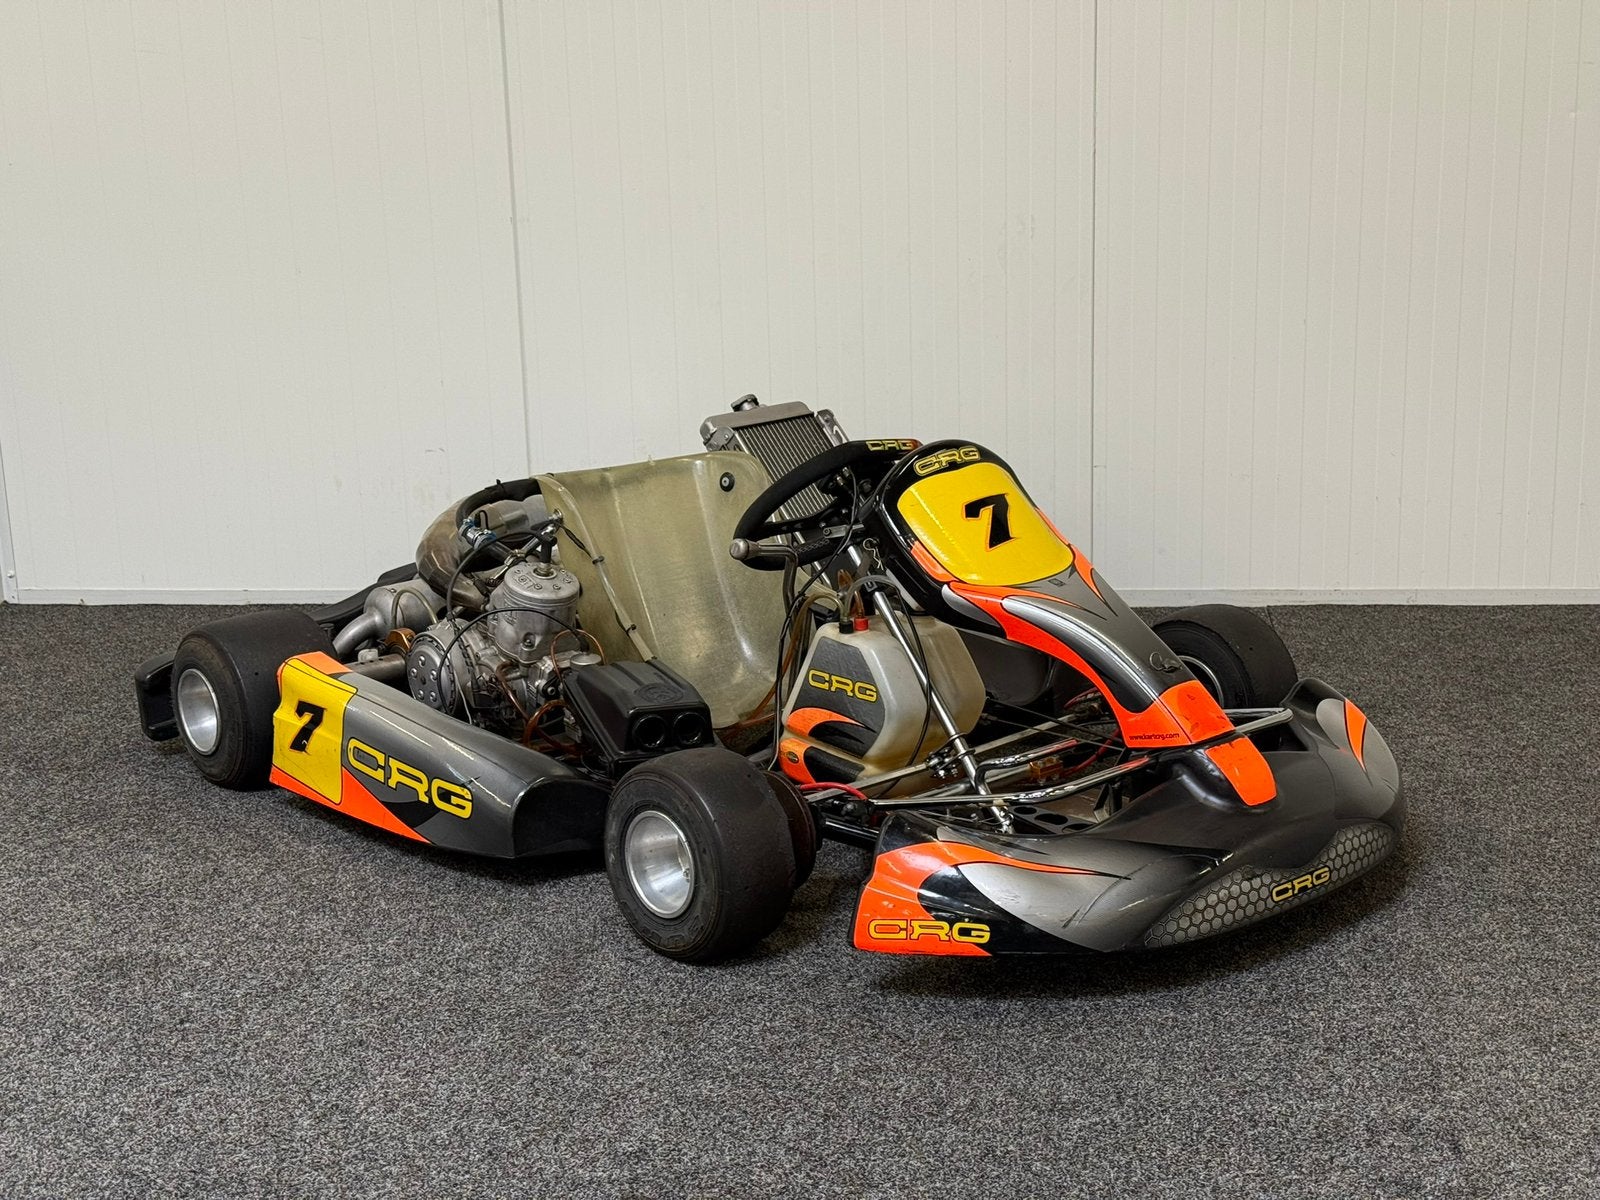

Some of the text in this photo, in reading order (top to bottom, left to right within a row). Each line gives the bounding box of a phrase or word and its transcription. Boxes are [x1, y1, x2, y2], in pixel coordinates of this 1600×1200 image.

[866, 440, 913, 451] CRG
[914, 446, 981, 475] CRG
[963, 492, 1016, 551] 7
[808, 669, 878, 703] CRG
[289, 701, 326, 753] 7
[347, 737, 474, 819] CRG
[1271, 866, 1331, 902] CRG
[868, 919, 991, 944] CRG
